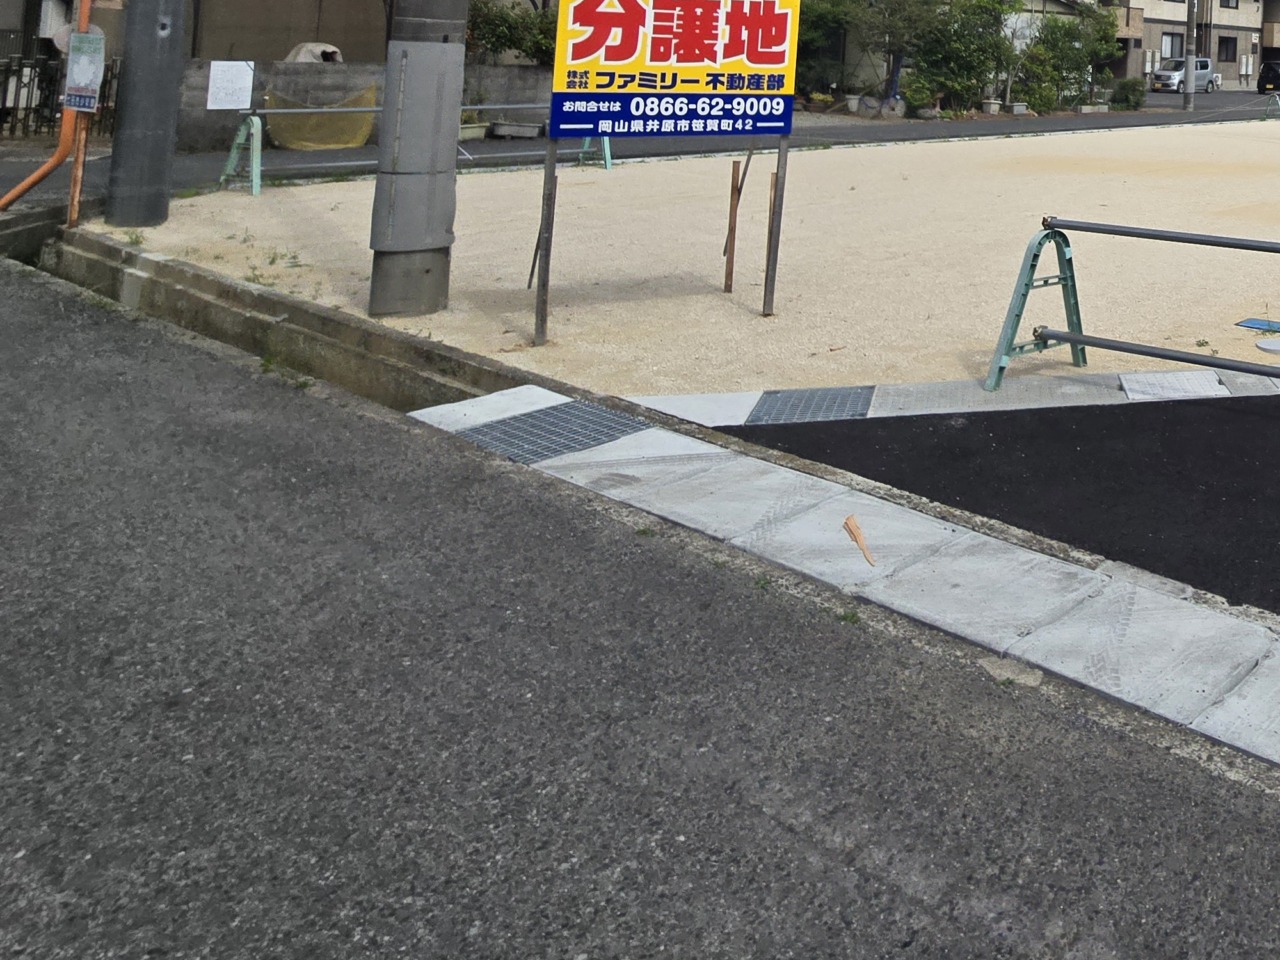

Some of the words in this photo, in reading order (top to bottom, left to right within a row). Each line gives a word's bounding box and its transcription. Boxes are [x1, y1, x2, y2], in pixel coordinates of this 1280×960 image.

[562, 101, 622, 112] お問合せは
[630, 97, 785, 116] 0866-62-9009
[598, 119, 753, 133] 岡山県井原市笹賀町42
